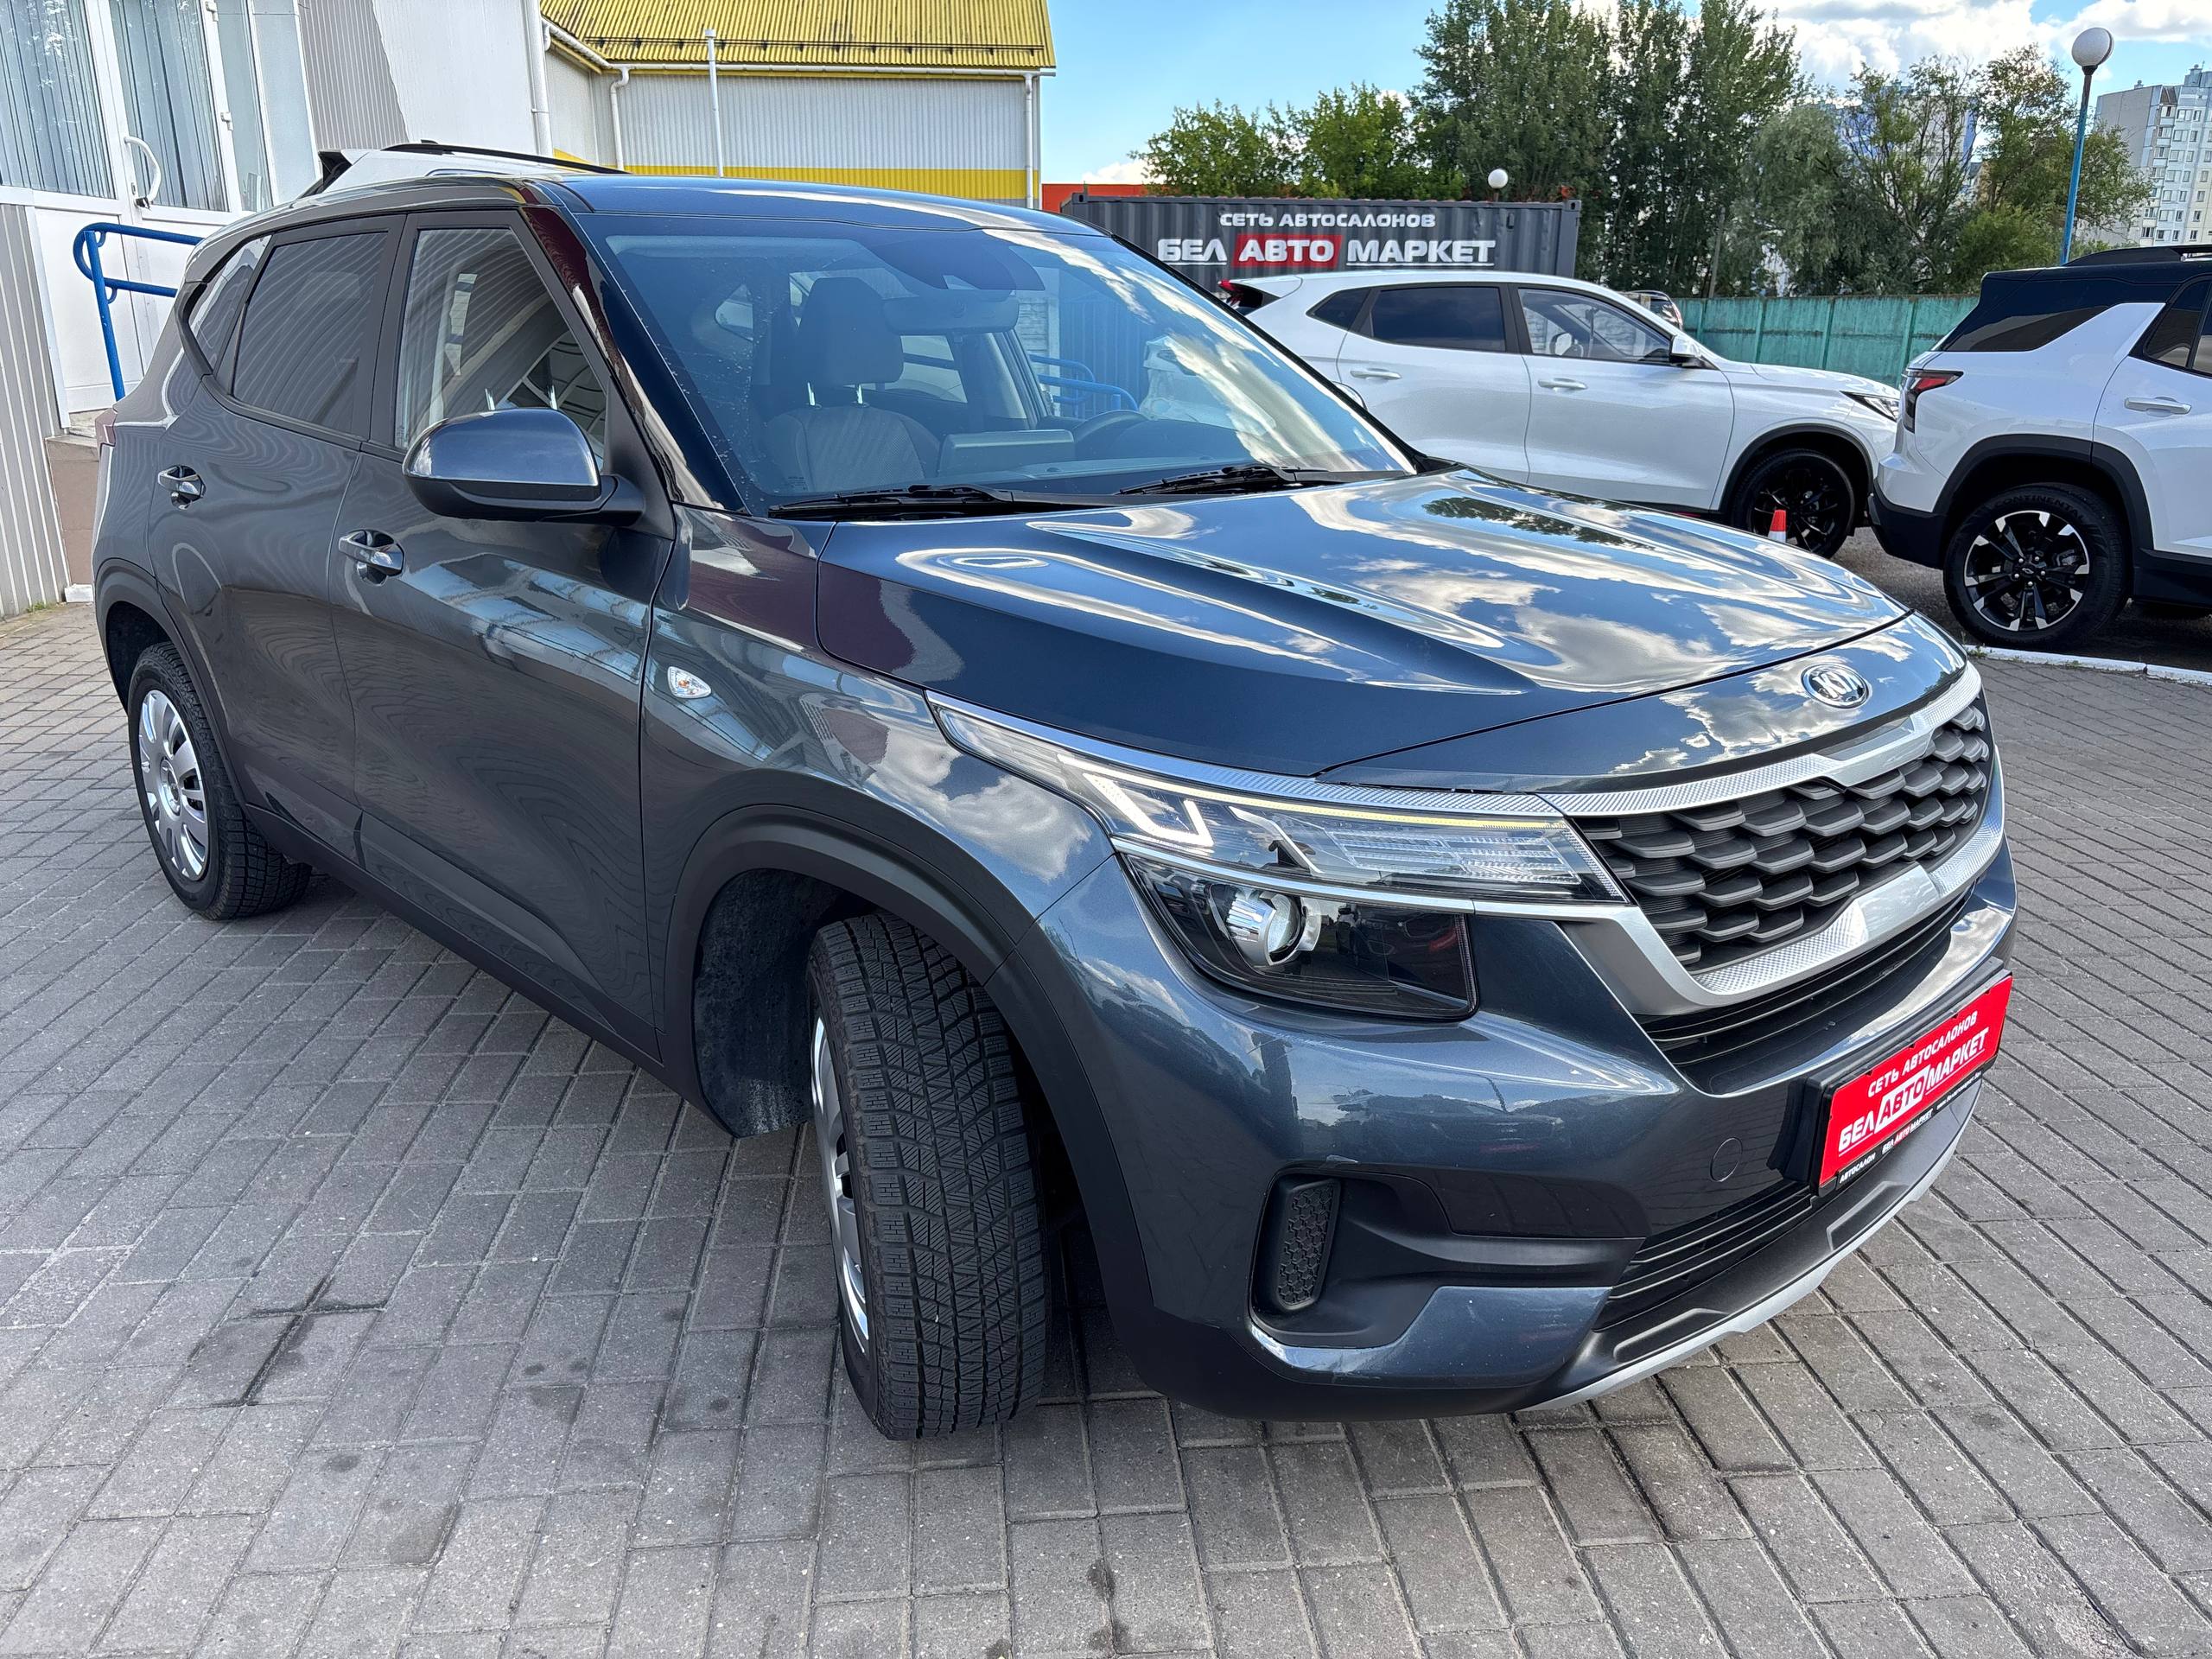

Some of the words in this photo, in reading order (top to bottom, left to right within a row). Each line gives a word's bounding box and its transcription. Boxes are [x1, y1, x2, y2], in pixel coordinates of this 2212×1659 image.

[1220, 213, 1274, 227] СЕТЬ
[1278, 213, 1436, 227] АВТОСАЛОНОВ
[1158, 238, 1227, 262] БЕЛ
[1238, 239, 1335, 263] АВТО
[1346, 239, 1496, 263] МАРКЕТ
[1867, 1068, 1899, 1098] СЕТЬ
[1901, 1010, 1978, 1076] АВТОСАЛОНОВ
